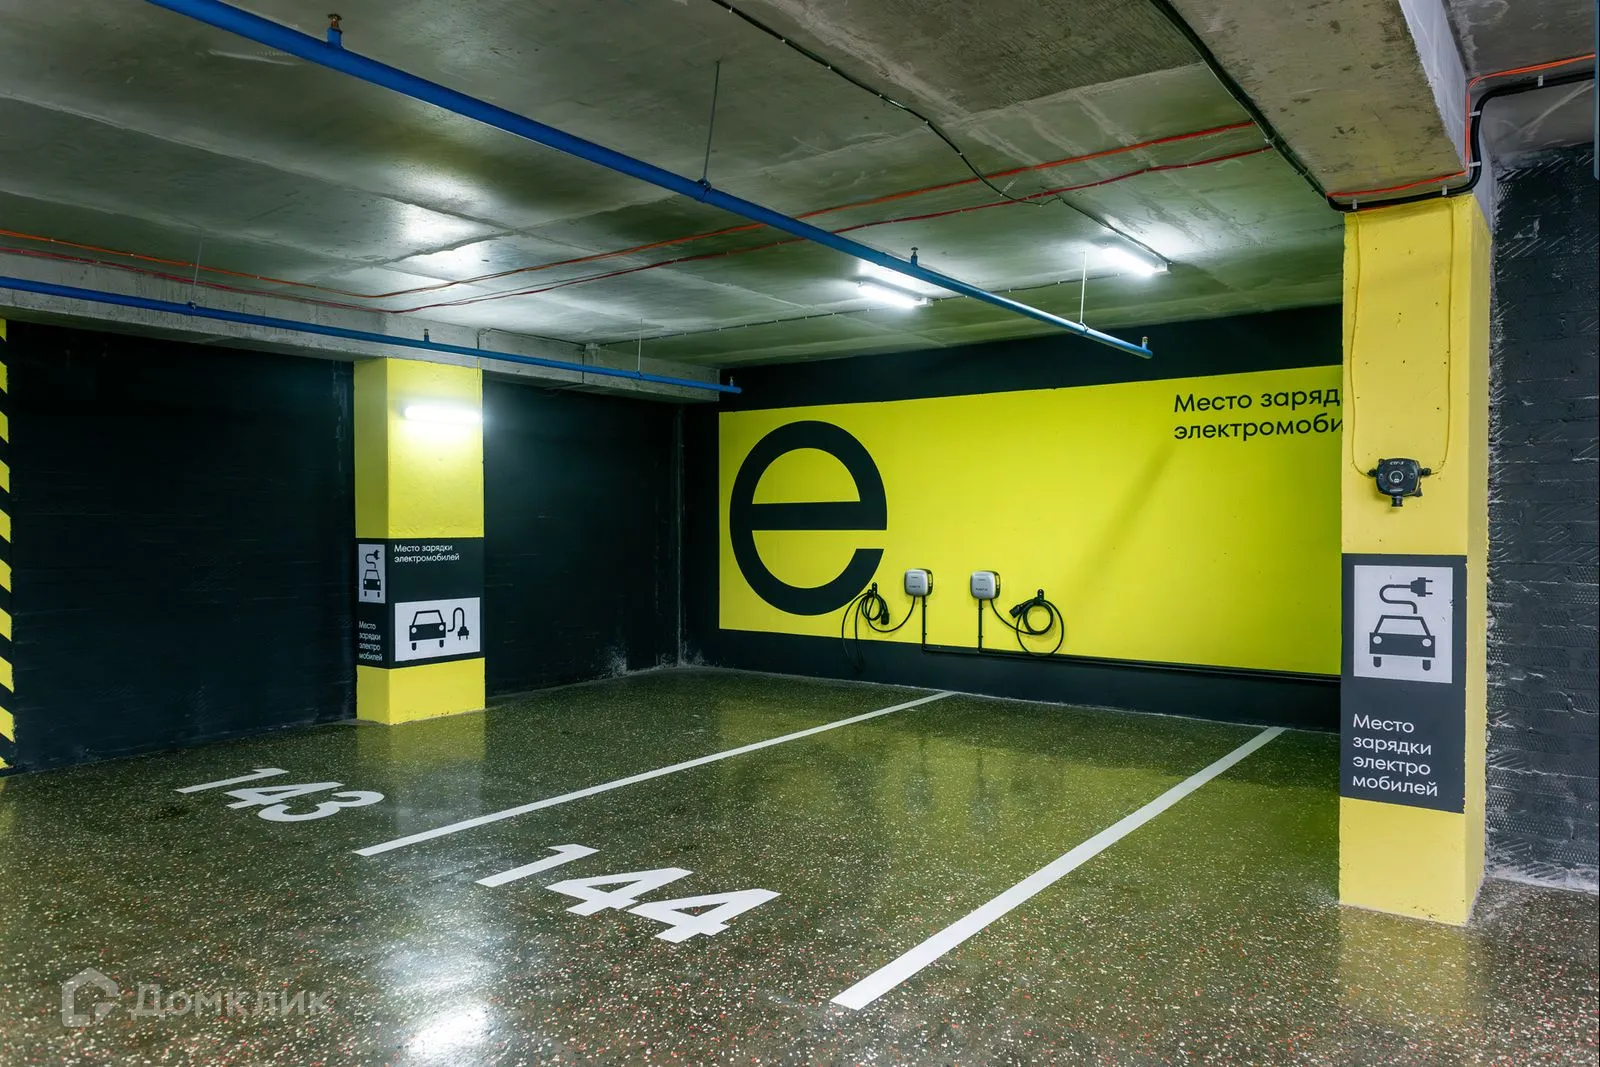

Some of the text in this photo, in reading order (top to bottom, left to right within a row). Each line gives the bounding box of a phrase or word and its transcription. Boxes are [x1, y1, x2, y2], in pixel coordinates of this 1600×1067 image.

[1174, 388, 1341, 413] Место заряд
[729, 420, 887, 616] e
[394, 544, 453, 552] Место зарядки
[394, 553, 460, 564] электромобилей
[358, 620, 377, 631] Место
[358, 632, 381, 642] зарядки
[358, 652, 383, 662] мобилей
[1352, 713, 1415, 733] Место
[1352, 736, 1432, 756] зарядки
[1352, 756, 1431, 777] электро
[174, 768, 384, 822] 143
[1352, 775, 1438, 797] мобилей
[475, 843, 781, 943] 144
